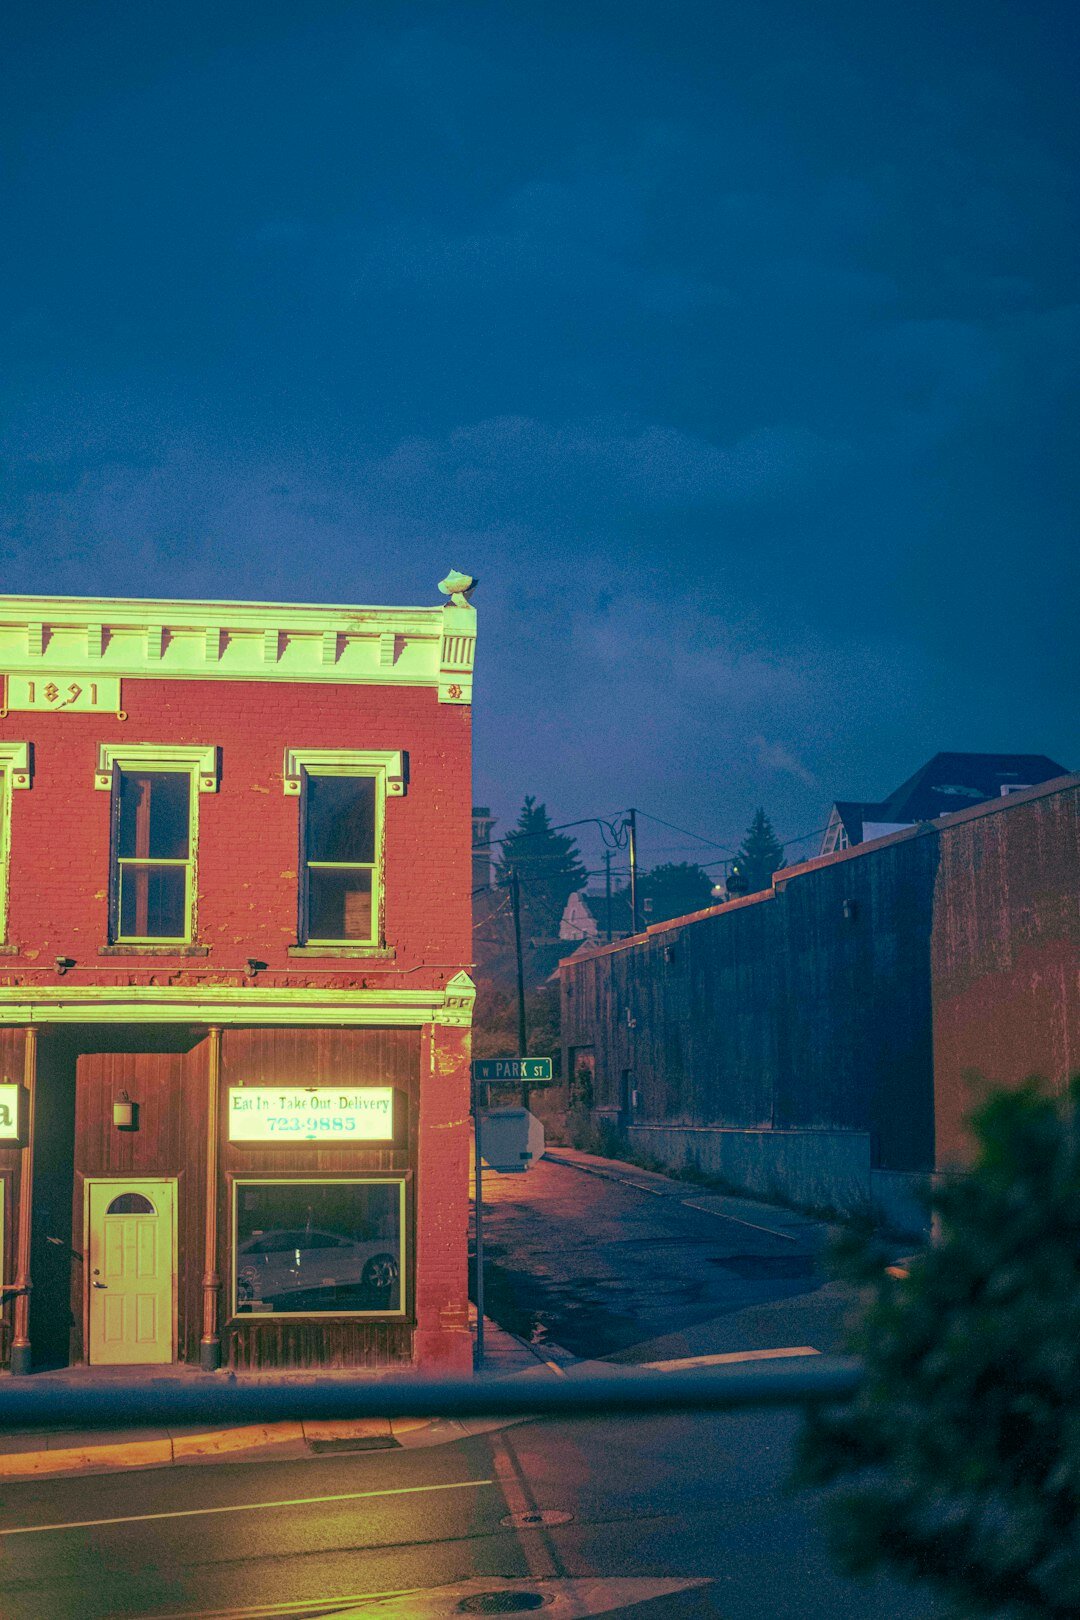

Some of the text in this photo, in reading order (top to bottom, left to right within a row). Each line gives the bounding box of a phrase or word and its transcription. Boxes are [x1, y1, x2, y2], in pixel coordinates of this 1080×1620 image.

[28, 681, 98, 705] 1891
[482, 1062, 543, 1077] W PARK ST
[232, 1096, 390, 1113] Eat In Take Out Delivery
[266, 1117, 356, 1131] 723-9885
